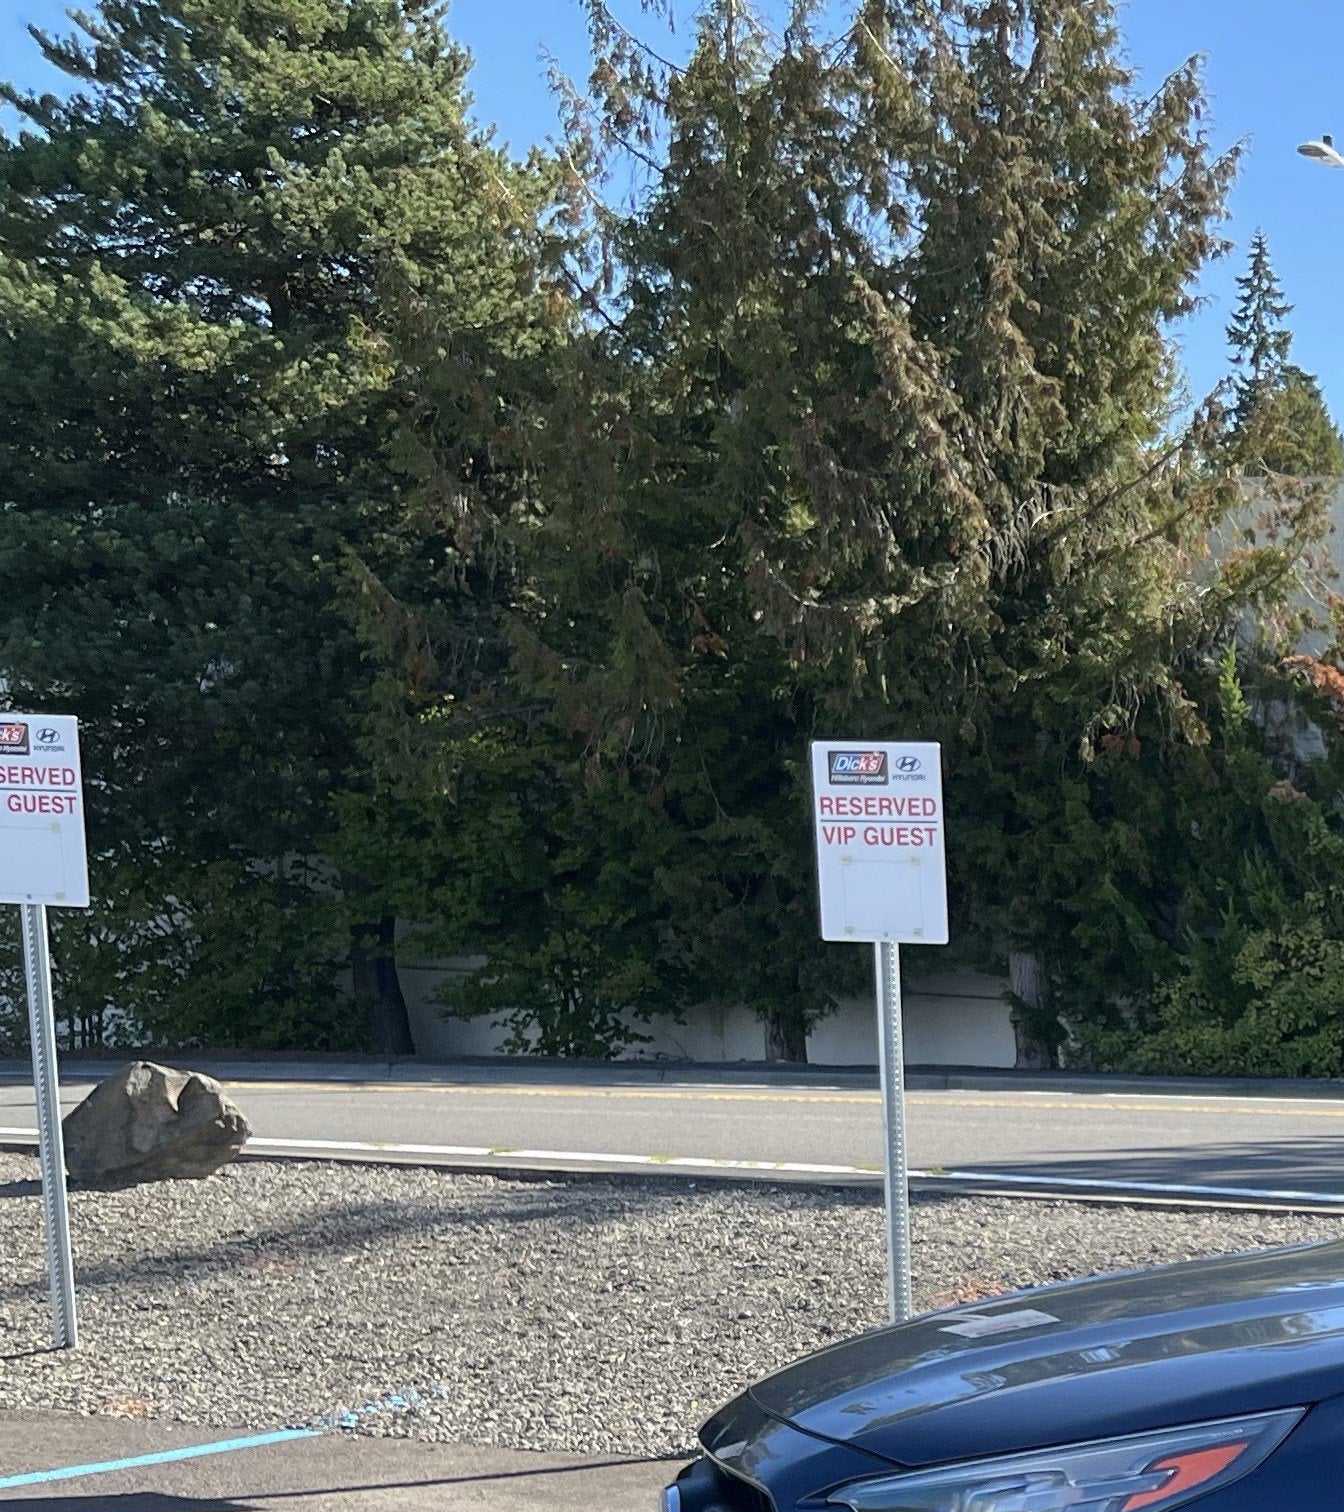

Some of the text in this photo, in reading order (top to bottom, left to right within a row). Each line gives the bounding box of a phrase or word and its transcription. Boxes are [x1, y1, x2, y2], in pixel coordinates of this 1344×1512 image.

[8, 794, 77, 814] GUEST
[820, 796, 936, 816] RESERVED
[822, 826, 937, 846] VIP GUEST
